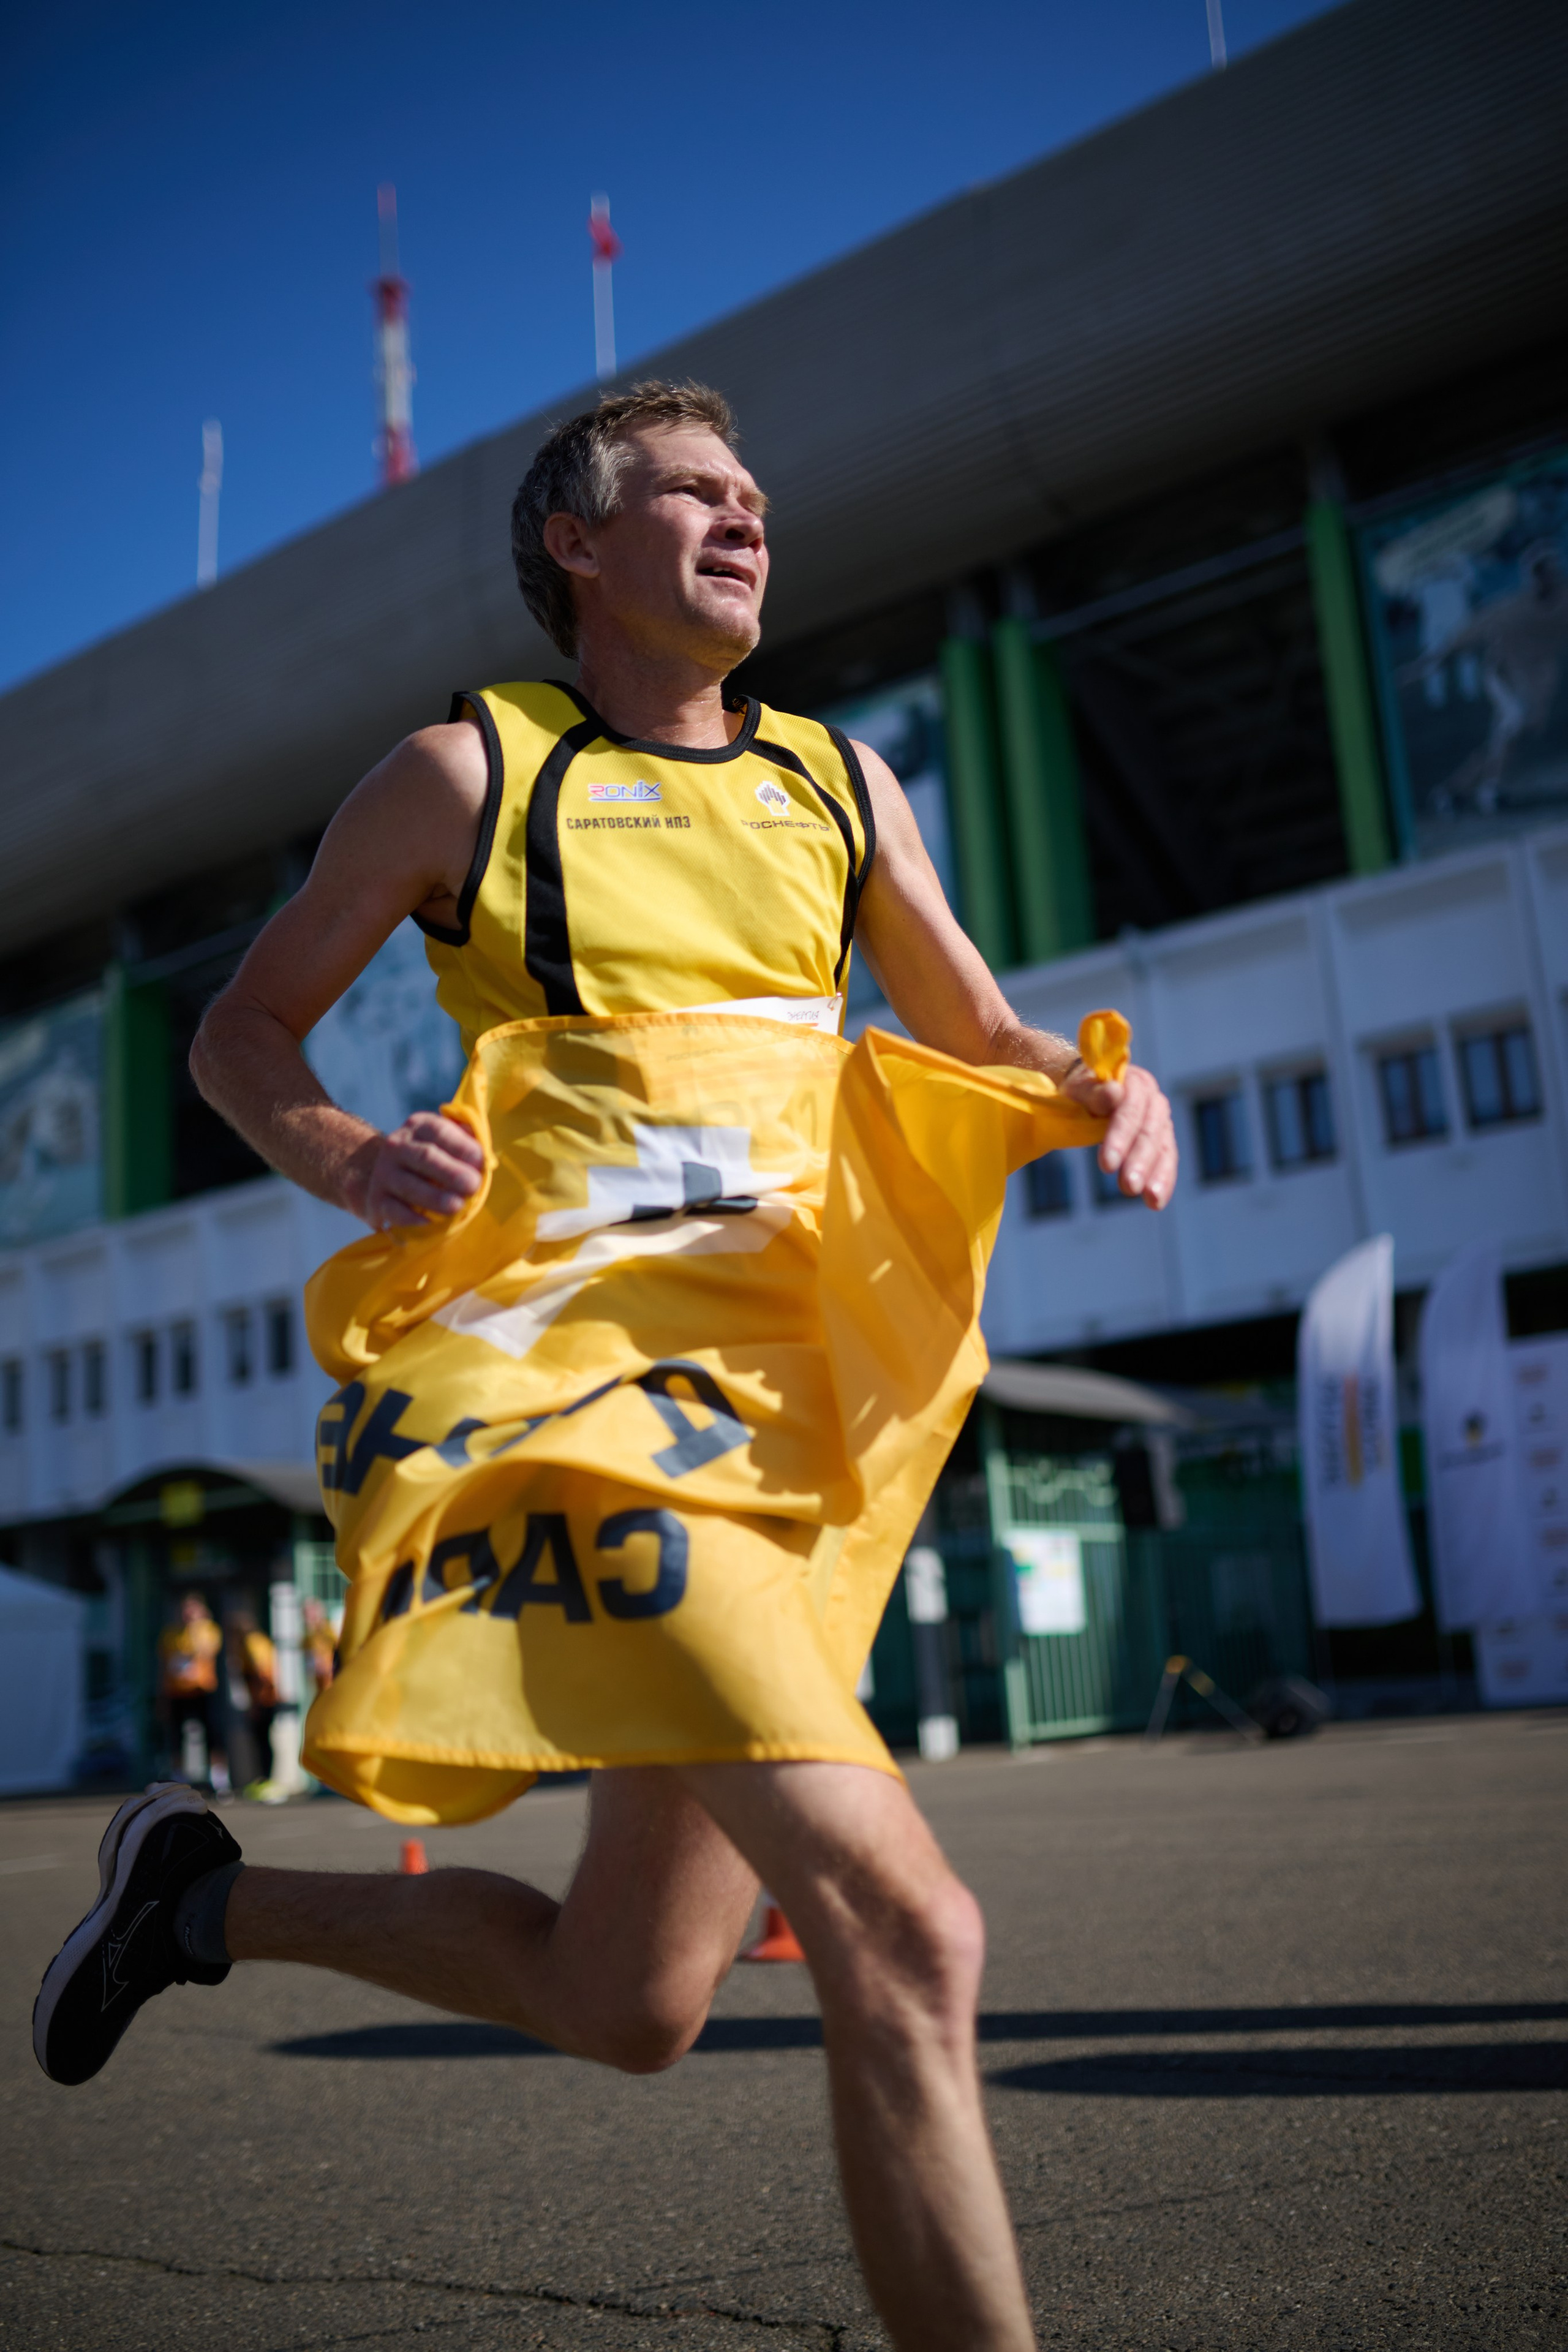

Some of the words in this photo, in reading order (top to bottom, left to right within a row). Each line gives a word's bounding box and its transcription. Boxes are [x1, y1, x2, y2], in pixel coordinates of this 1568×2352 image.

[567, 815, 661, 830] САРАТОВСКИЙ
[665, 816, 691, 829] НПЗ
[741, 820, 830, 831] РОСНЕФТЬ
